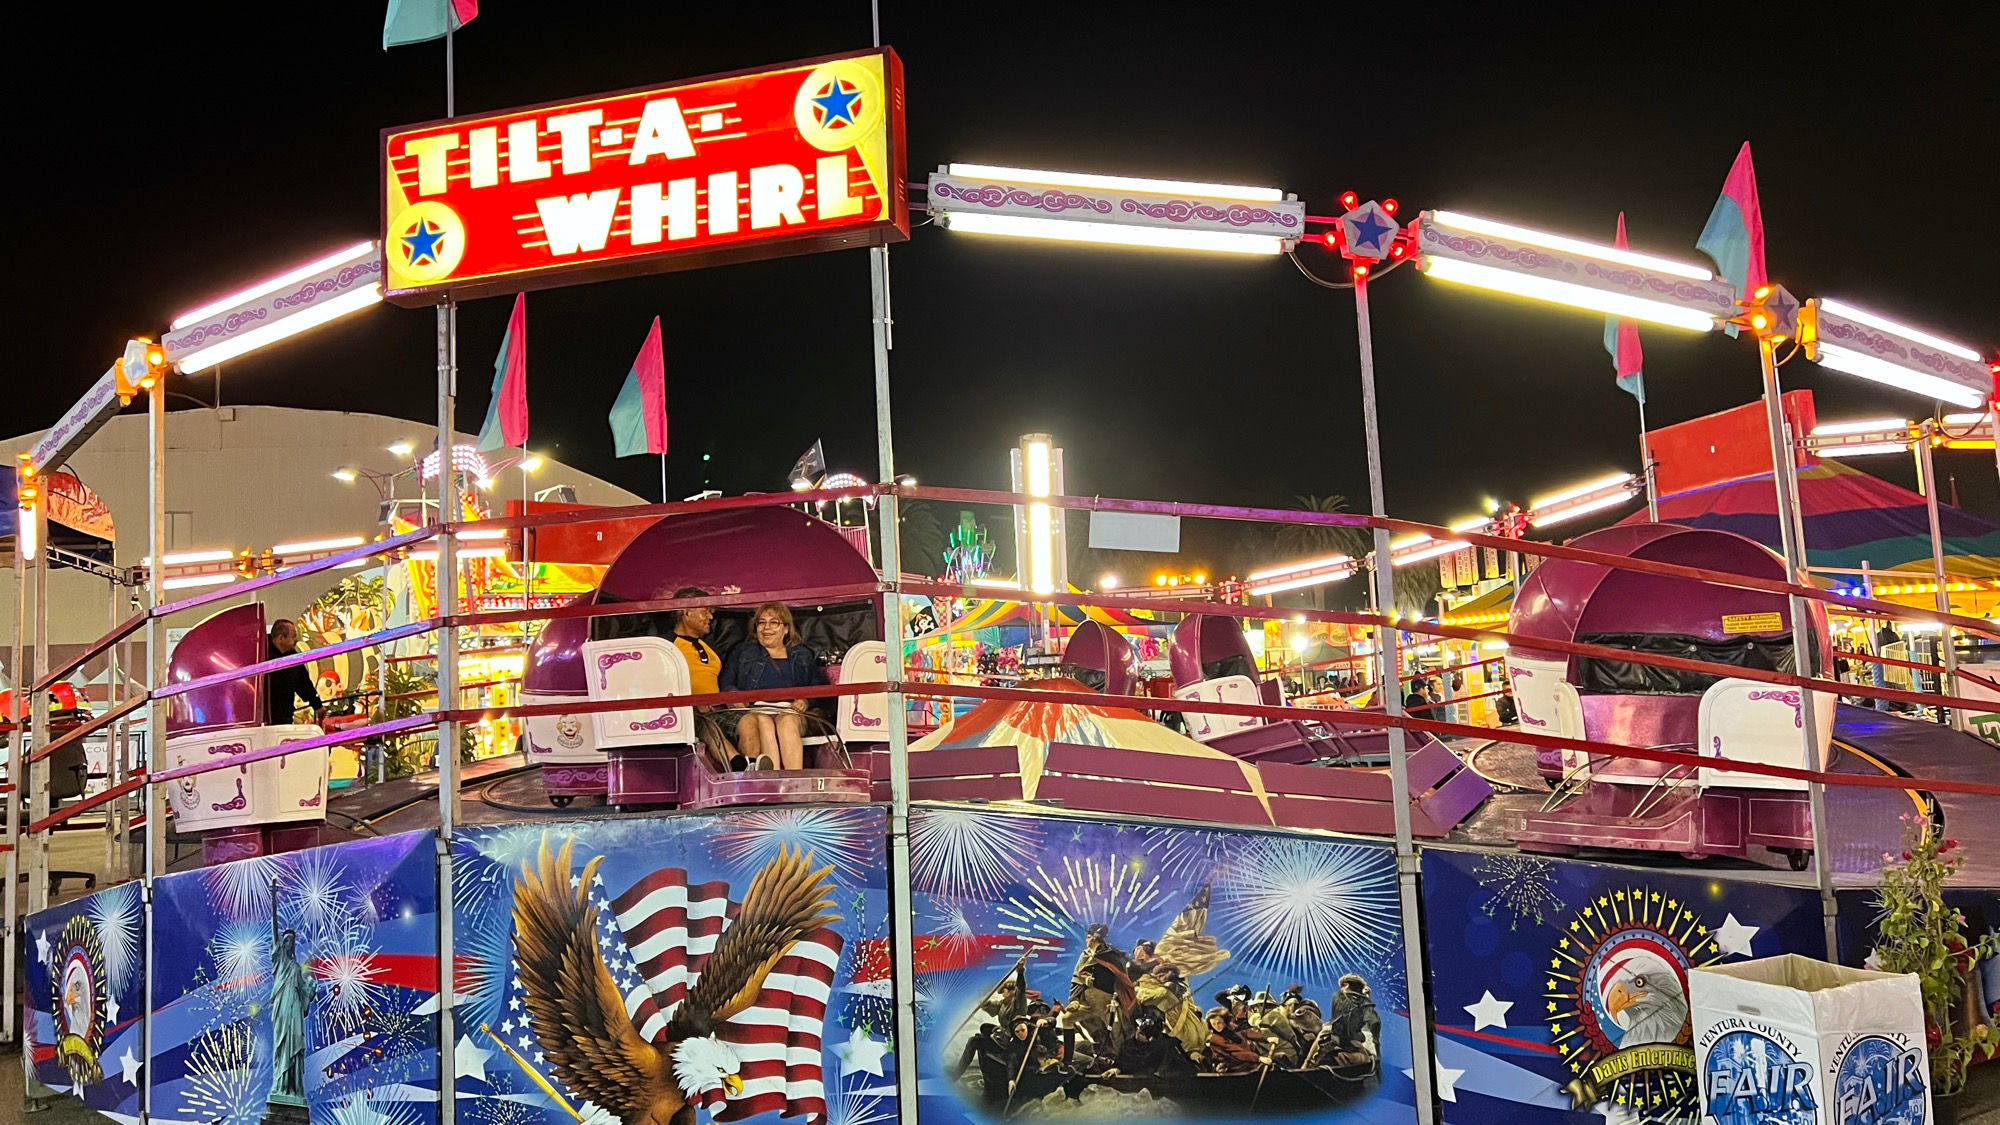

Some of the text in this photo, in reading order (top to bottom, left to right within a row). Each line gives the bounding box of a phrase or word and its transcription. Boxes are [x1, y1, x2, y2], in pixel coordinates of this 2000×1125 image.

[405, 97, 723, 196] TILT-A-
[536, 154, 863, 256] WHIRL
[1699, 1017, 1802, 1058] VENTURA COUNTY
[1829, 1032, 1859, 1074] VENTU
[1592, 1055, 1629, 1084] Davis
[1705, 1062, 1818, 1116] FAIR
[1837, 1047, 1927, 1125] FAIR
